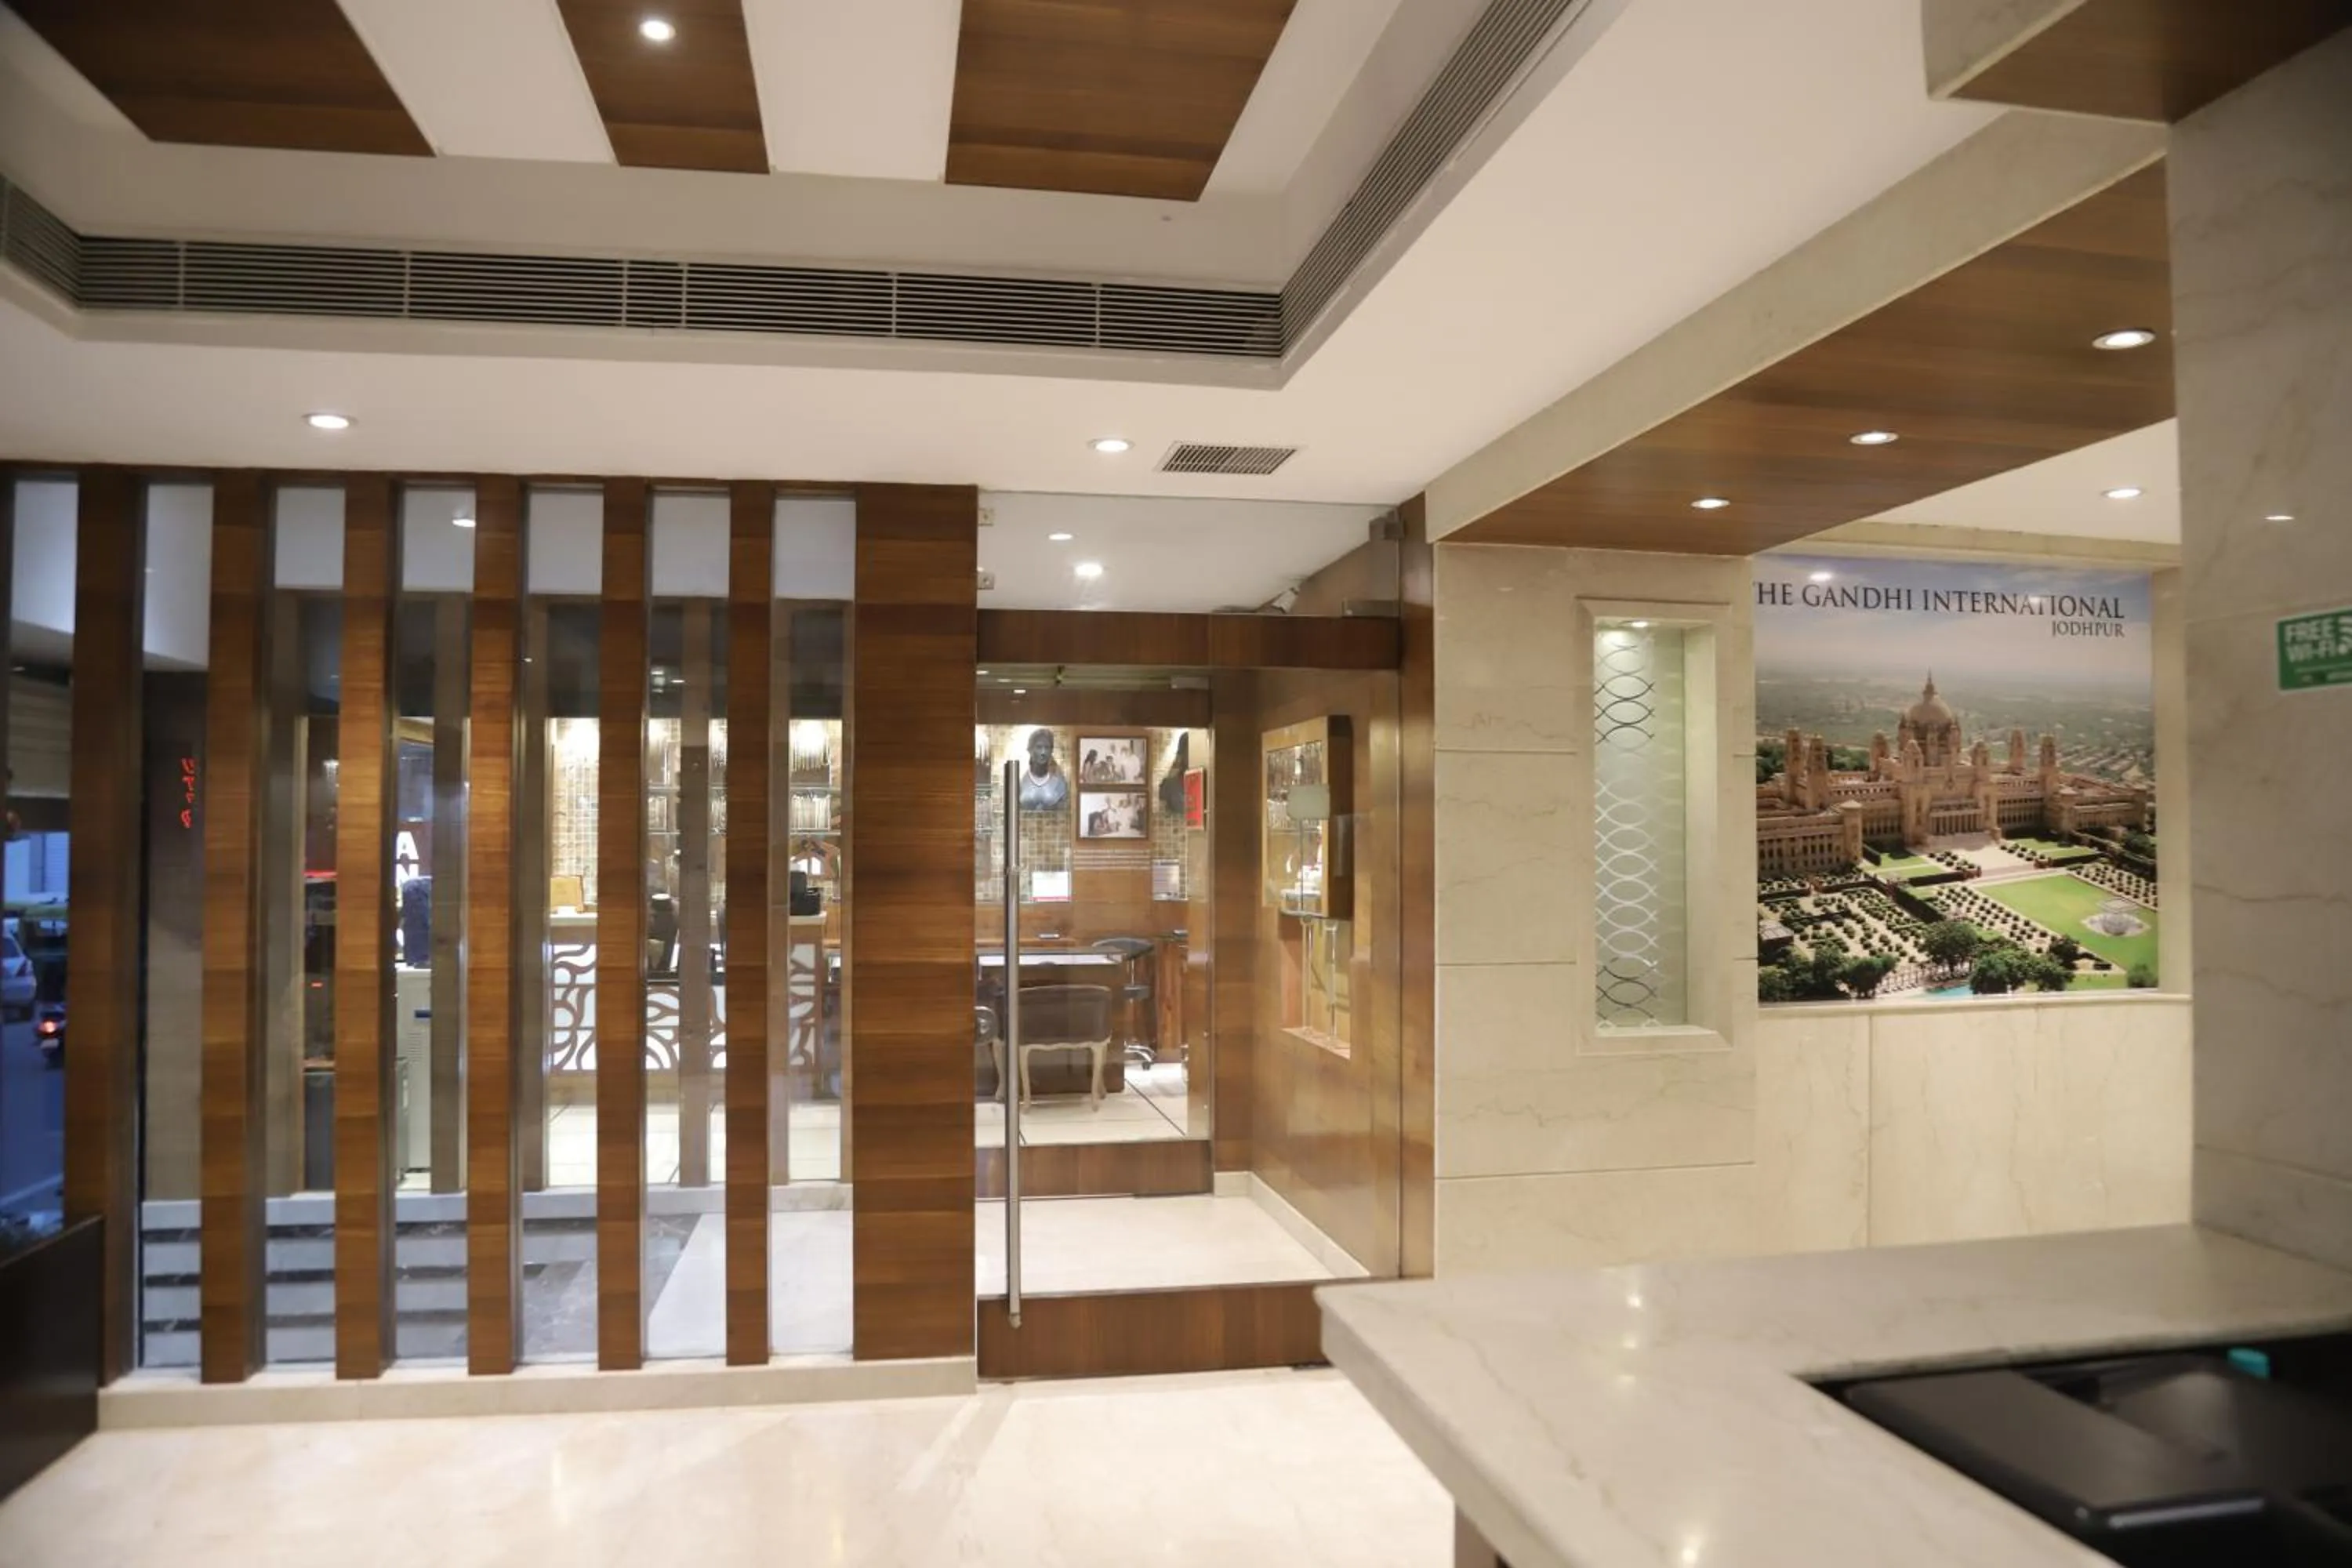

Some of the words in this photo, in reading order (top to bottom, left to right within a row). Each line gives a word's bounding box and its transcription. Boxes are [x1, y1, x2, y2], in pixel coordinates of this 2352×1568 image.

[1753, 580, 1793, 605] HE
[1802, 584, 1912, 611] GANDHI
[1922, 589, 2125, 619] INTERNATIONAL
[2051, 620, 2125, 638] JODHPUR
